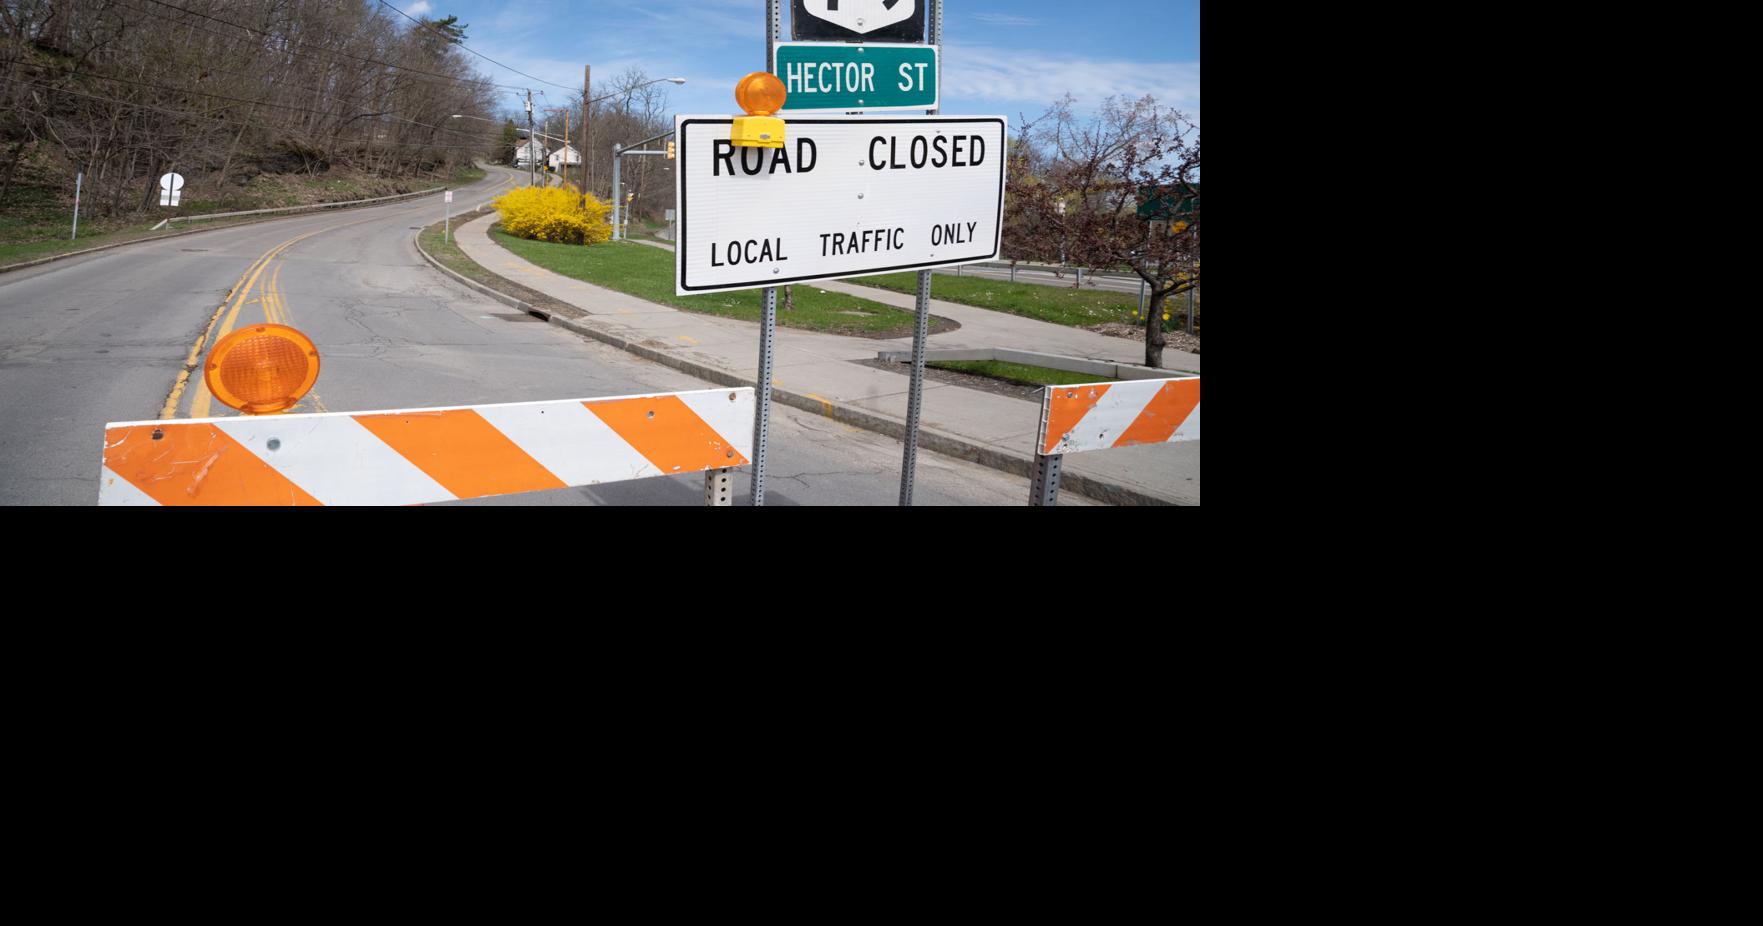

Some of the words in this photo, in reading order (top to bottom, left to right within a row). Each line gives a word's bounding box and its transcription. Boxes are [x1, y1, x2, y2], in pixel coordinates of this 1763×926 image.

[788, 62, 875, 93] HECTOR
[898, 62, 928, 92] ST
[713, 137, 817, 176] ROAD
[868, 135, 986, 171] CLOSED
[711, 237, 788, 267] LOCAL
[819, 228, 905, 256] TRAFFIC
[931, 221, 977, 246] ONLY
